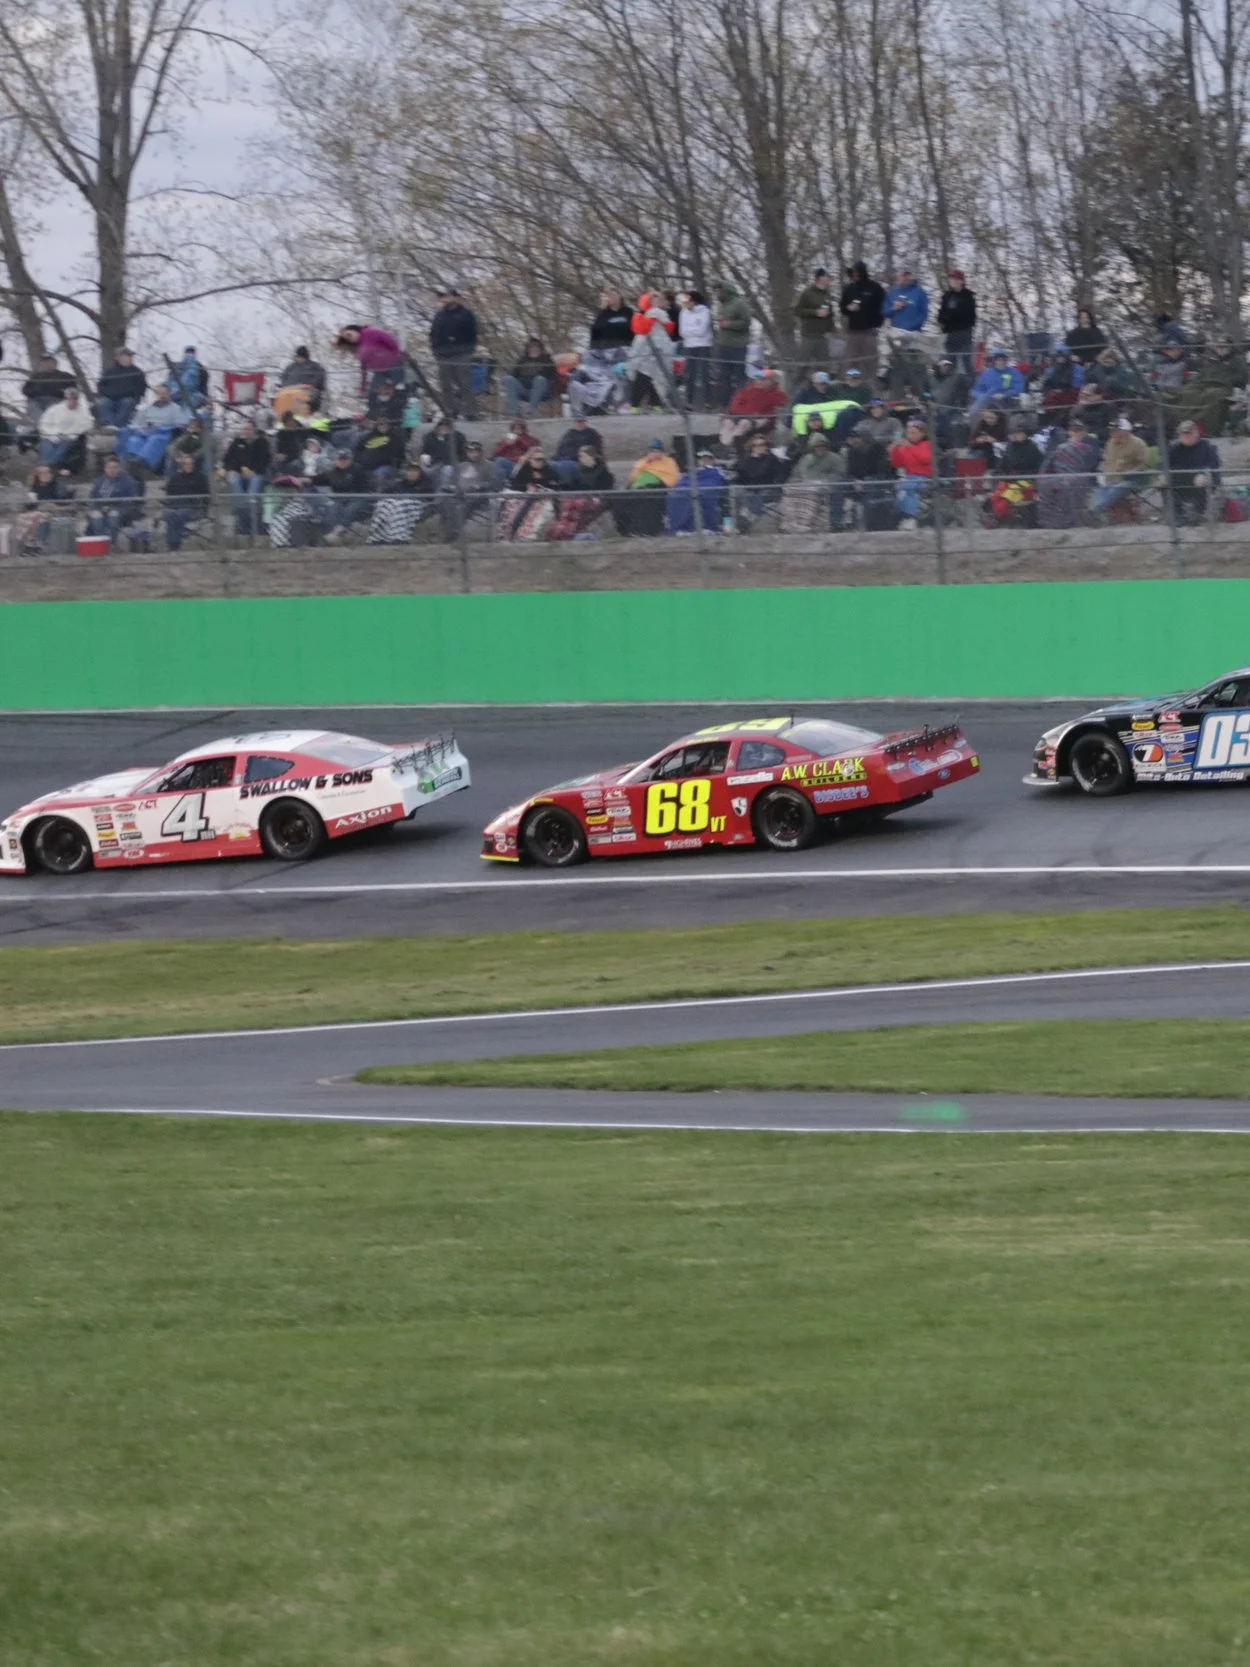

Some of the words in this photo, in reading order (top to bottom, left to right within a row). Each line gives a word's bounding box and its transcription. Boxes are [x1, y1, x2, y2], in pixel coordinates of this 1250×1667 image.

[240, 776, 312, 800] SWALLOW
[315, 773, 328, 789] &
[332, 768, 373, 788] SONS
[161, 792, 209, 842] 4
[335, 804, 392, 829] Axion
[645, 778, 711, 836] 68
[710, 816, 726, 832] VT
